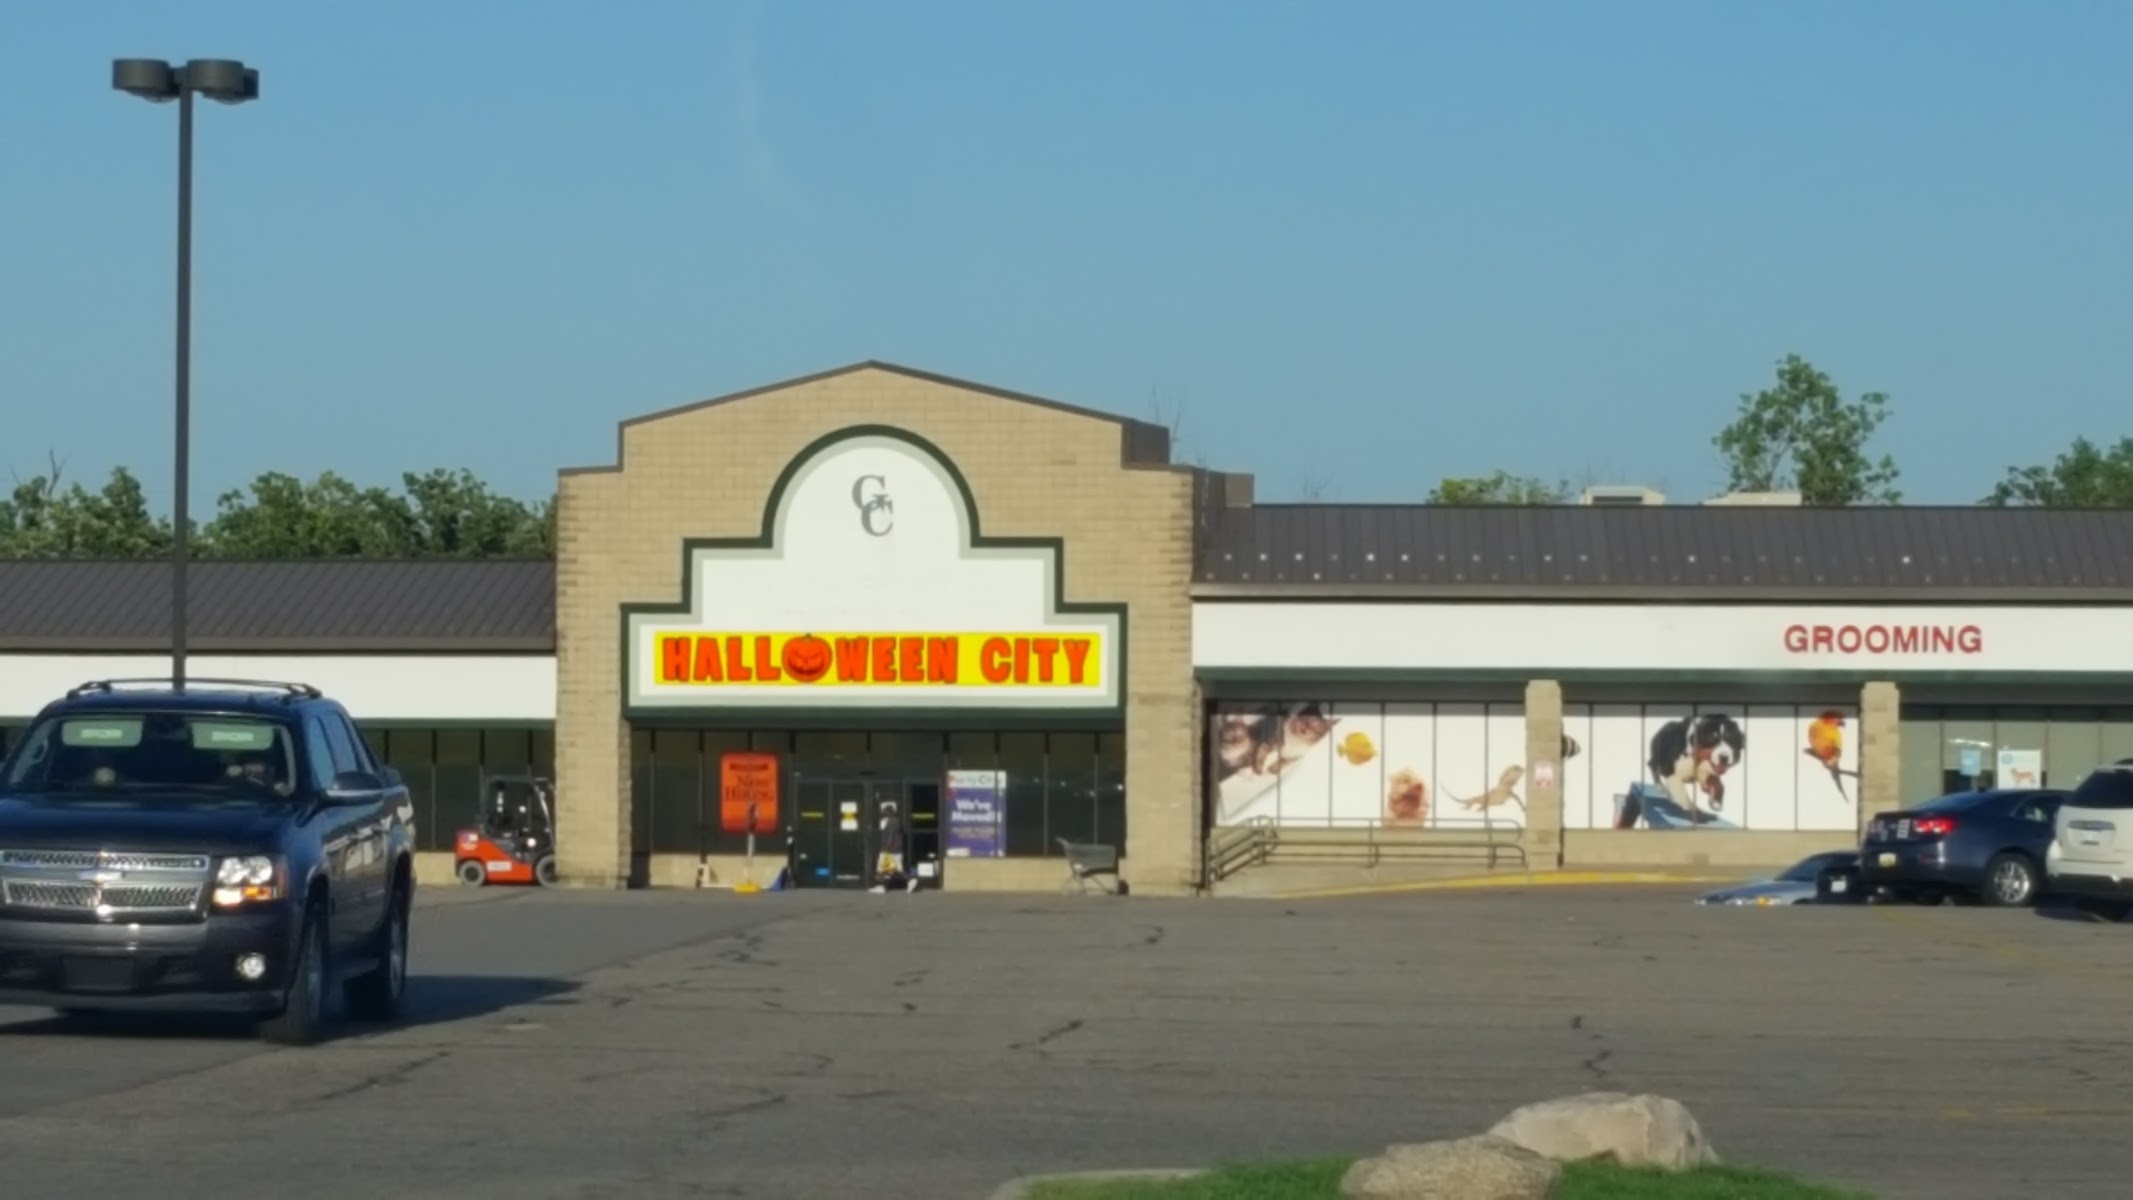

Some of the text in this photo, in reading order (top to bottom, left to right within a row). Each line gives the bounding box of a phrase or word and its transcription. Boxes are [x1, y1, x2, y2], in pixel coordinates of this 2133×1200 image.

[662, 634, 1091, 684] HALLOWEEN CITY
[1784, 624, 1982, 654] GROOMING
